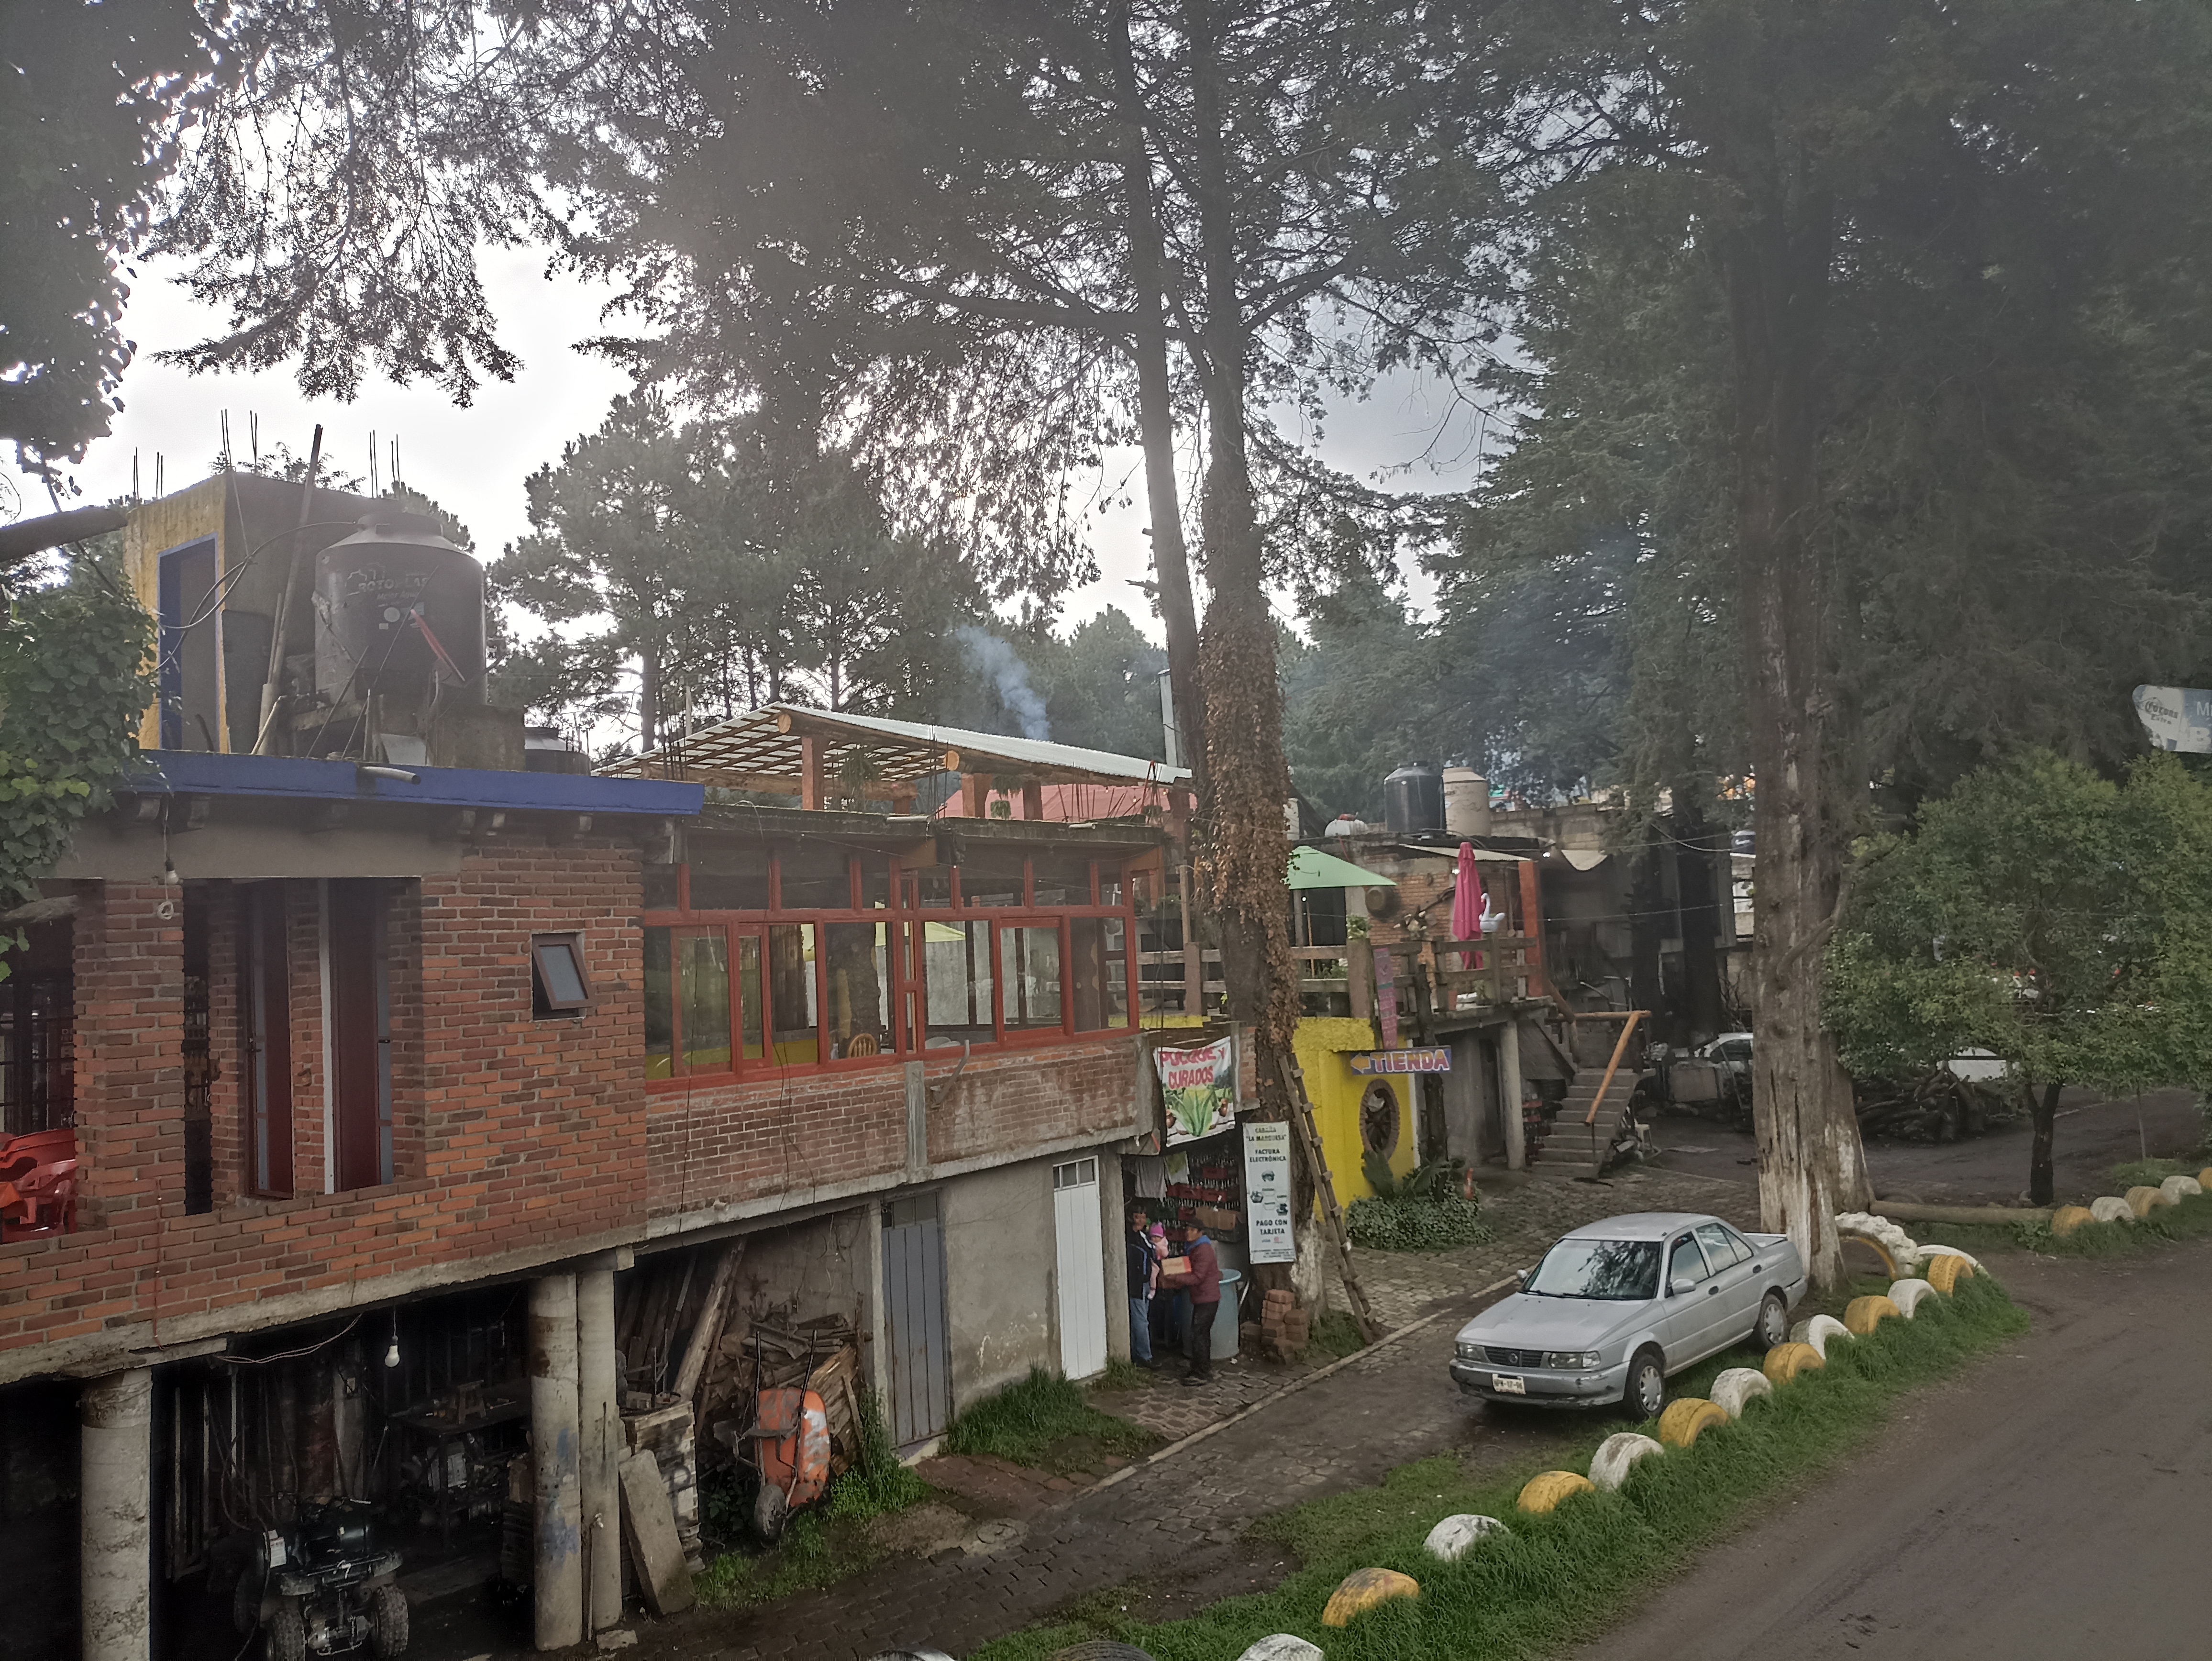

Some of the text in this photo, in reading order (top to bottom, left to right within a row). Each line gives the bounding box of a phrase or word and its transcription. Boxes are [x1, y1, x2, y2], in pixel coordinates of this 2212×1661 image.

[358, 577, 428, 592] ROTOLAS
[2145, 700, 2179, 719] Corona
[2197, 701, 2212, 717] M
[1159, 1046, 1217, 1068] PULQUE
[1370, 1049, 1450, 1073] TIENDA
[1168, 1065, 1213, 1090] CURADOS
